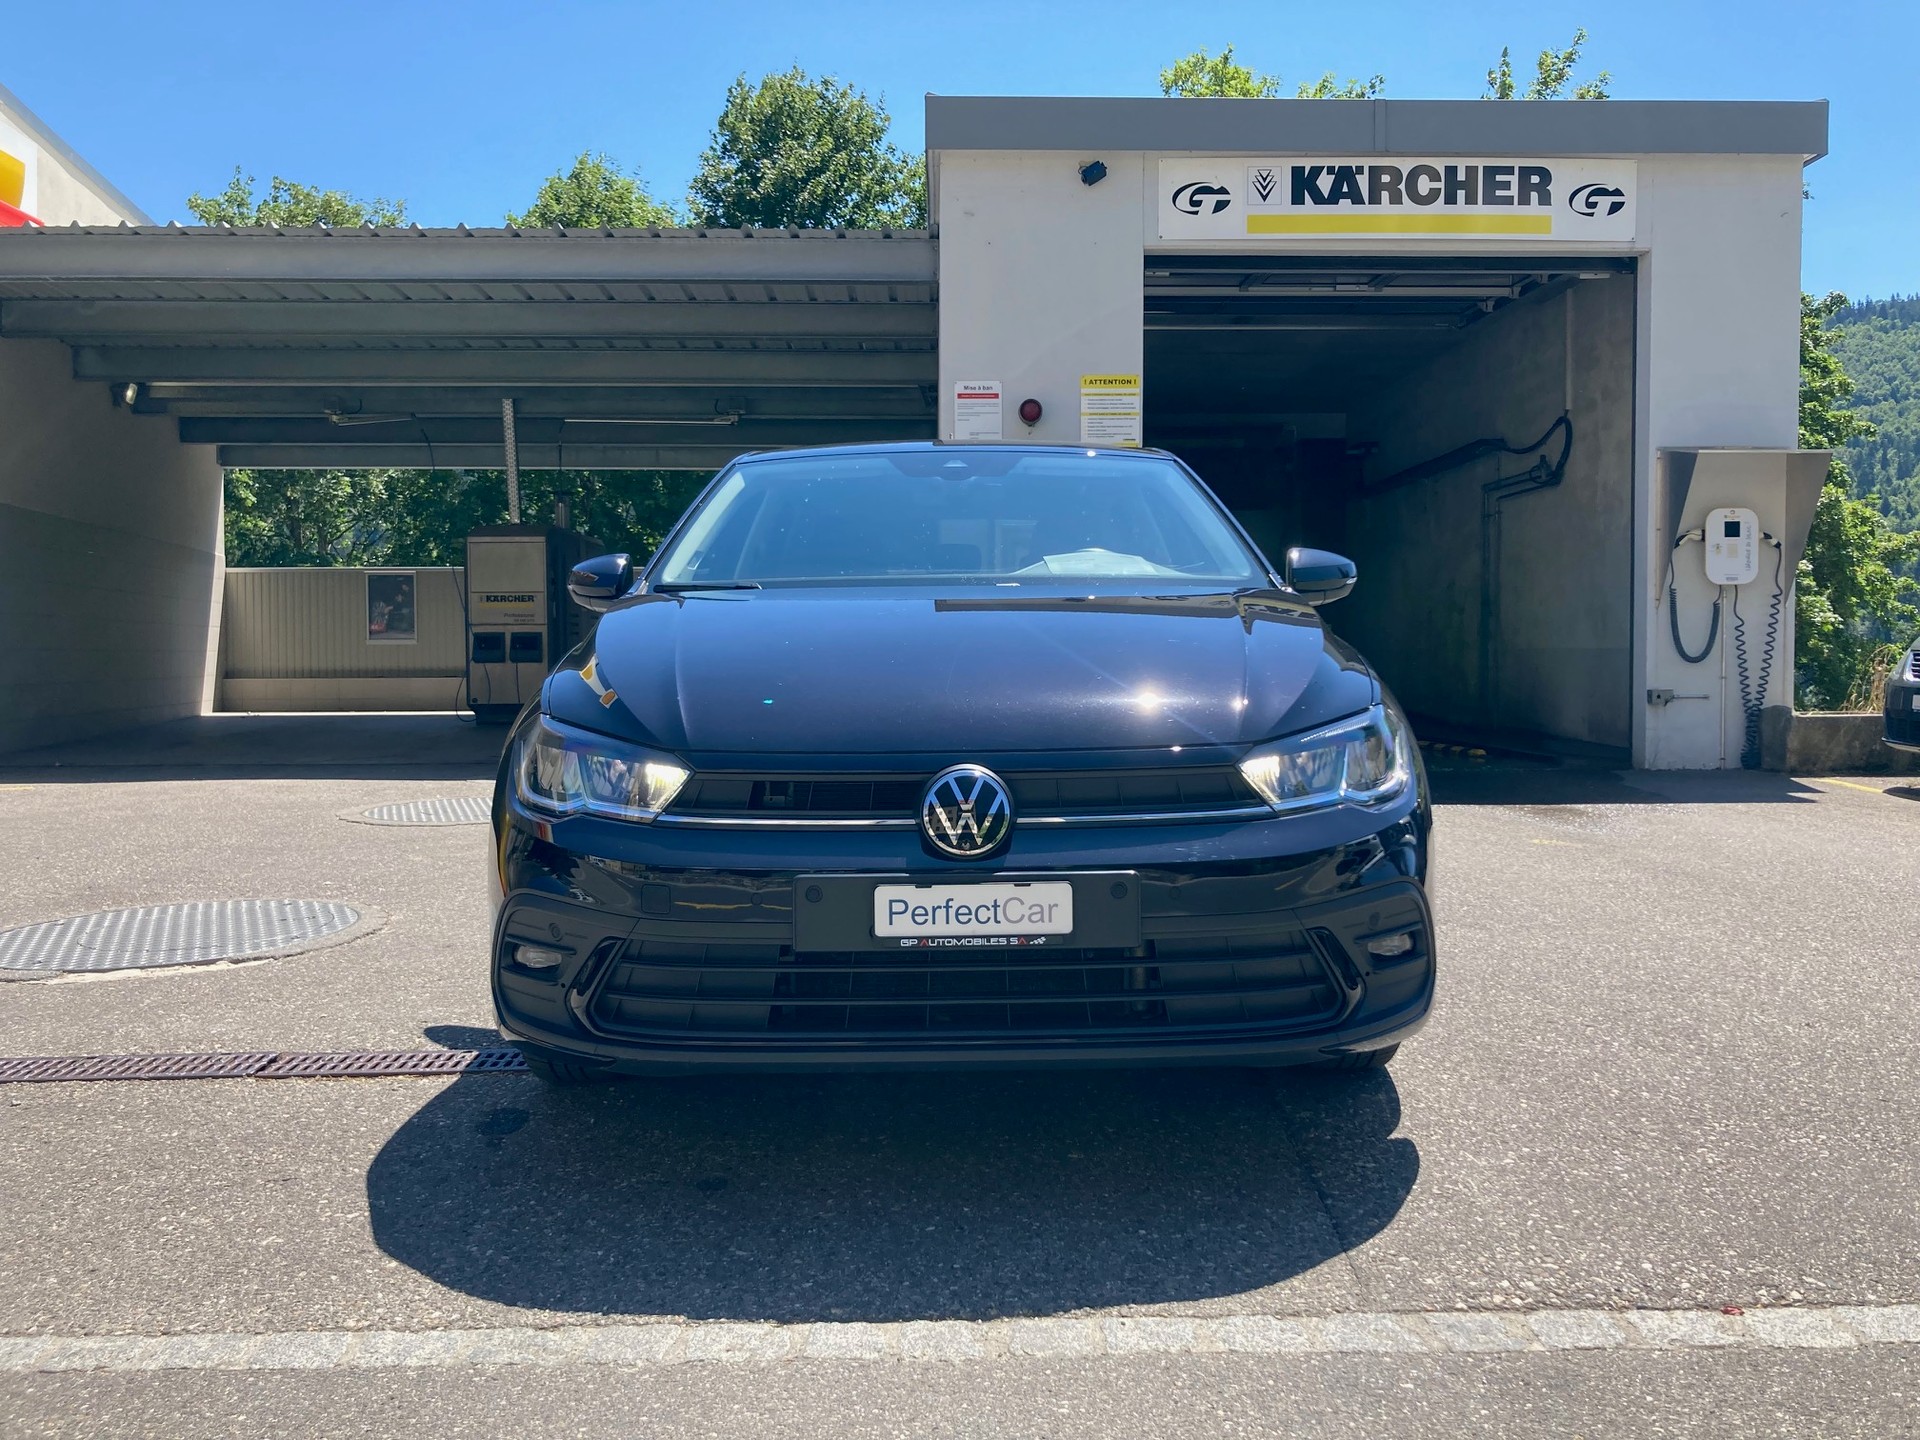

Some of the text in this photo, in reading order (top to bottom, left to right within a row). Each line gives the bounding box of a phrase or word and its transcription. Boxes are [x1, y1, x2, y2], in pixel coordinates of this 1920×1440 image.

[1290, 165, 1552, 206] KÄRCHER
[888, 896, 1059, 926] PerfectCar
[900, 936, 1027, 947] GP AUTOMOBILES SA
